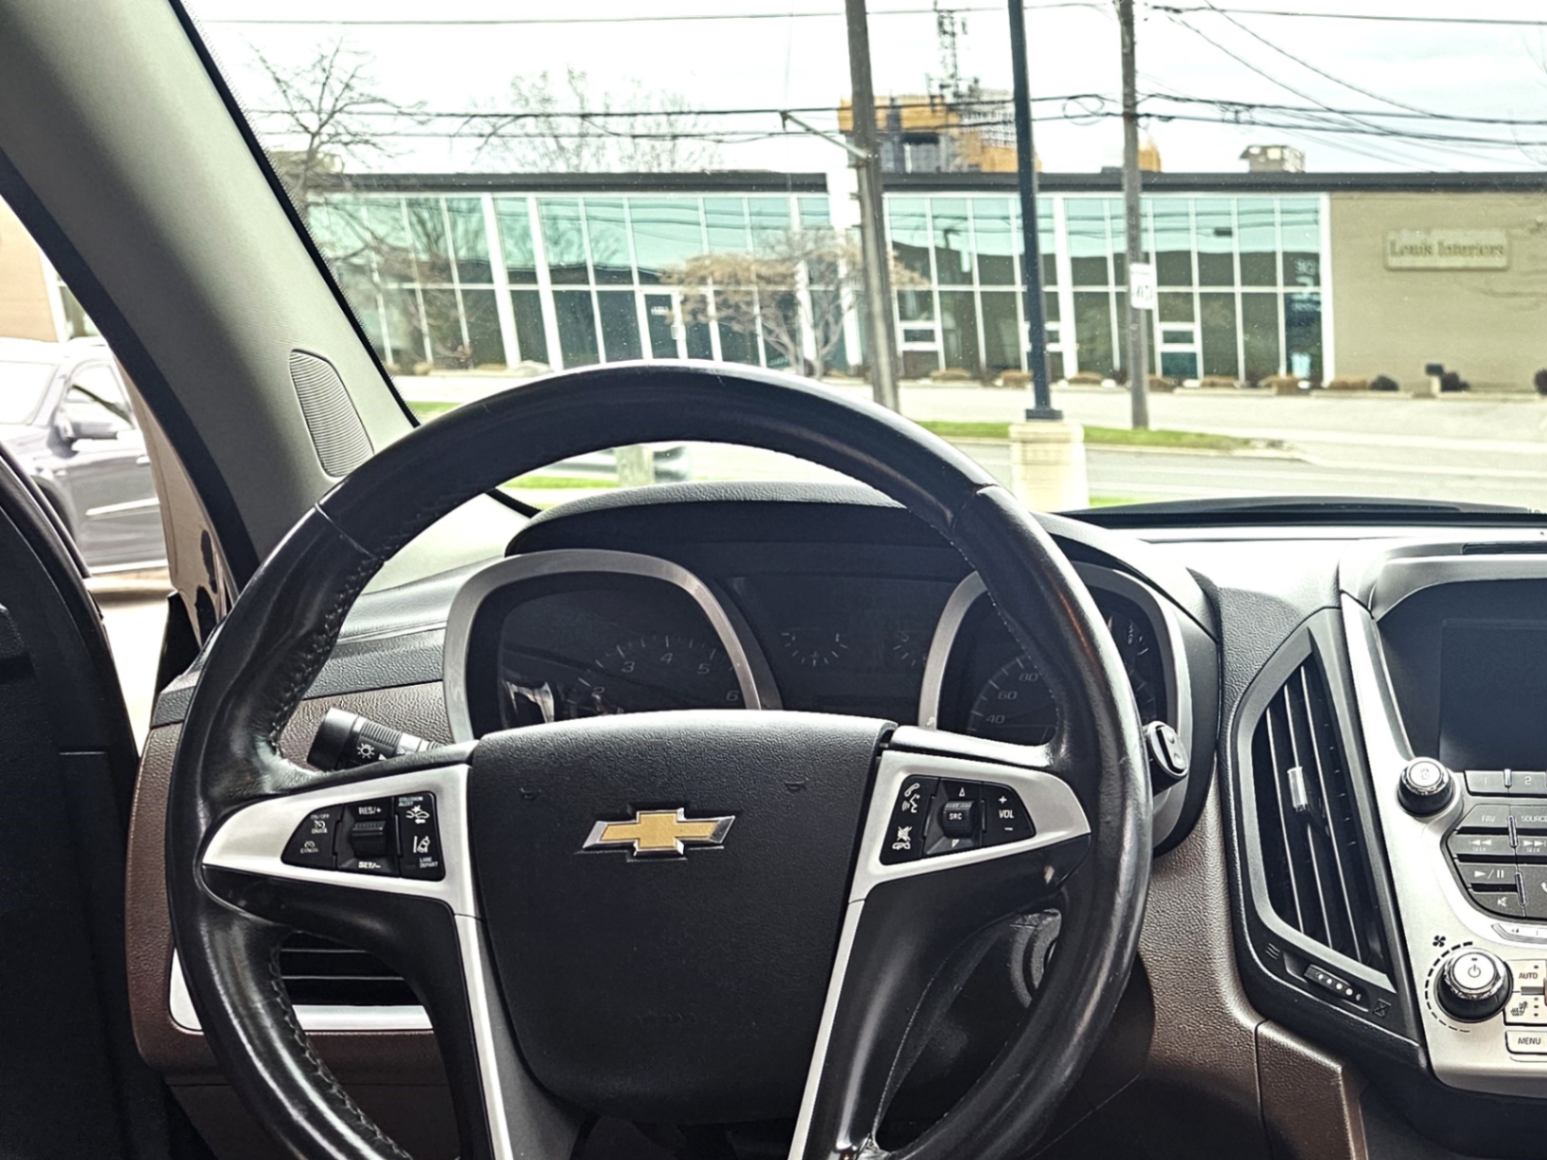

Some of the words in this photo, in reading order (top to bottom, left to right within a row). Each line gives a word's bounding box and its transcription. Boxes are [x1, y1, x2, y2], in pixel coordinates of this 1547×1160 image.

[621, 661, 636, 673] 3
[985, 714, 1006, 724] 40
[1524, 776, 1532, 785] 2
[999, 809, 1014, 819] VOL
[1521, 815, 1547, 823] SOURCE
[1517, 1036, 1542, 1046] MENU
